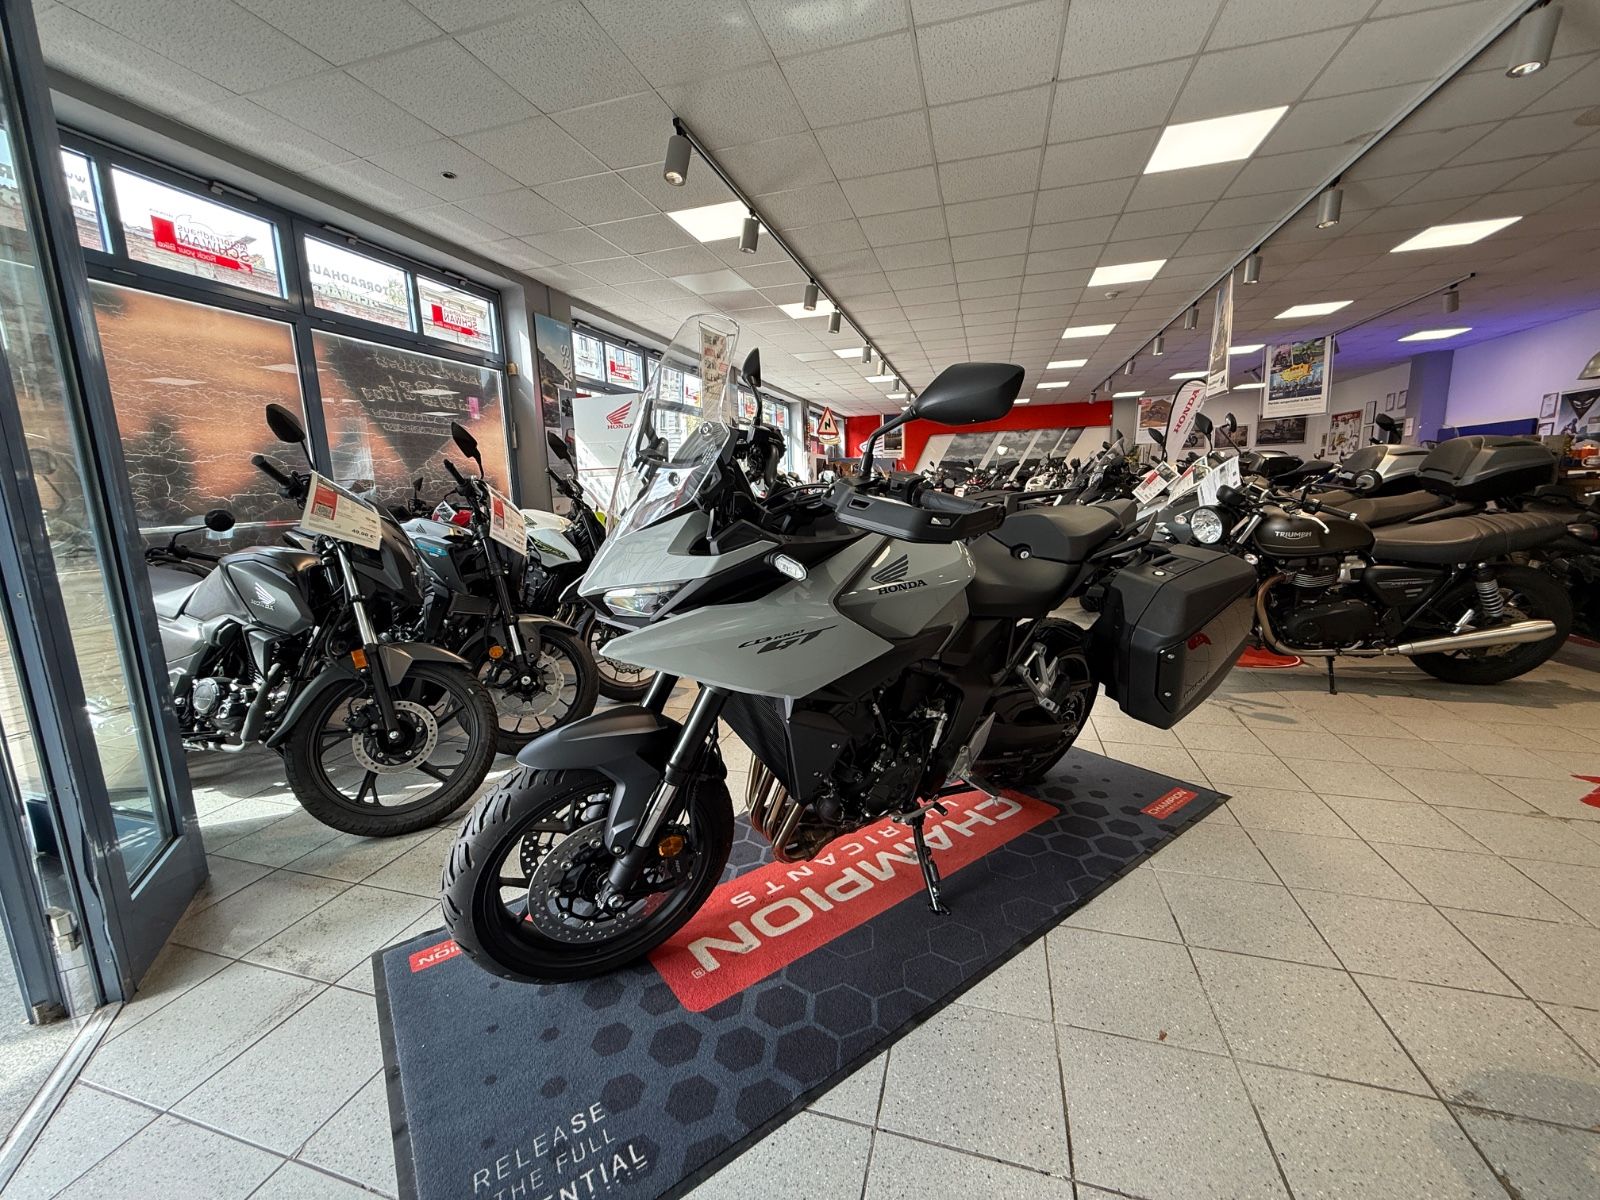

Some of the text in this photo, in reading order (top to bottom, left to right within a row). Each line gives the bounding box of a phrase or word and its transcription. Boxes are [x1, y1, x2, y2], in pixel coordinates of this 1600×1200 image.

[1172, 388, 1201, 434] HONDA
[1275, 531, 1312, 539] TRIUMPH
[878, 578, 928, 596] HONDA
[1148, 790, 1188, 815] CHAMPION
[730, 799, 959, 909] LURICANTS
[687, 797, 1024, 973] CHAMPION
[472, 1102, 606, 1194] RELEASE
[555, 1129, 616, 1174] FULL
